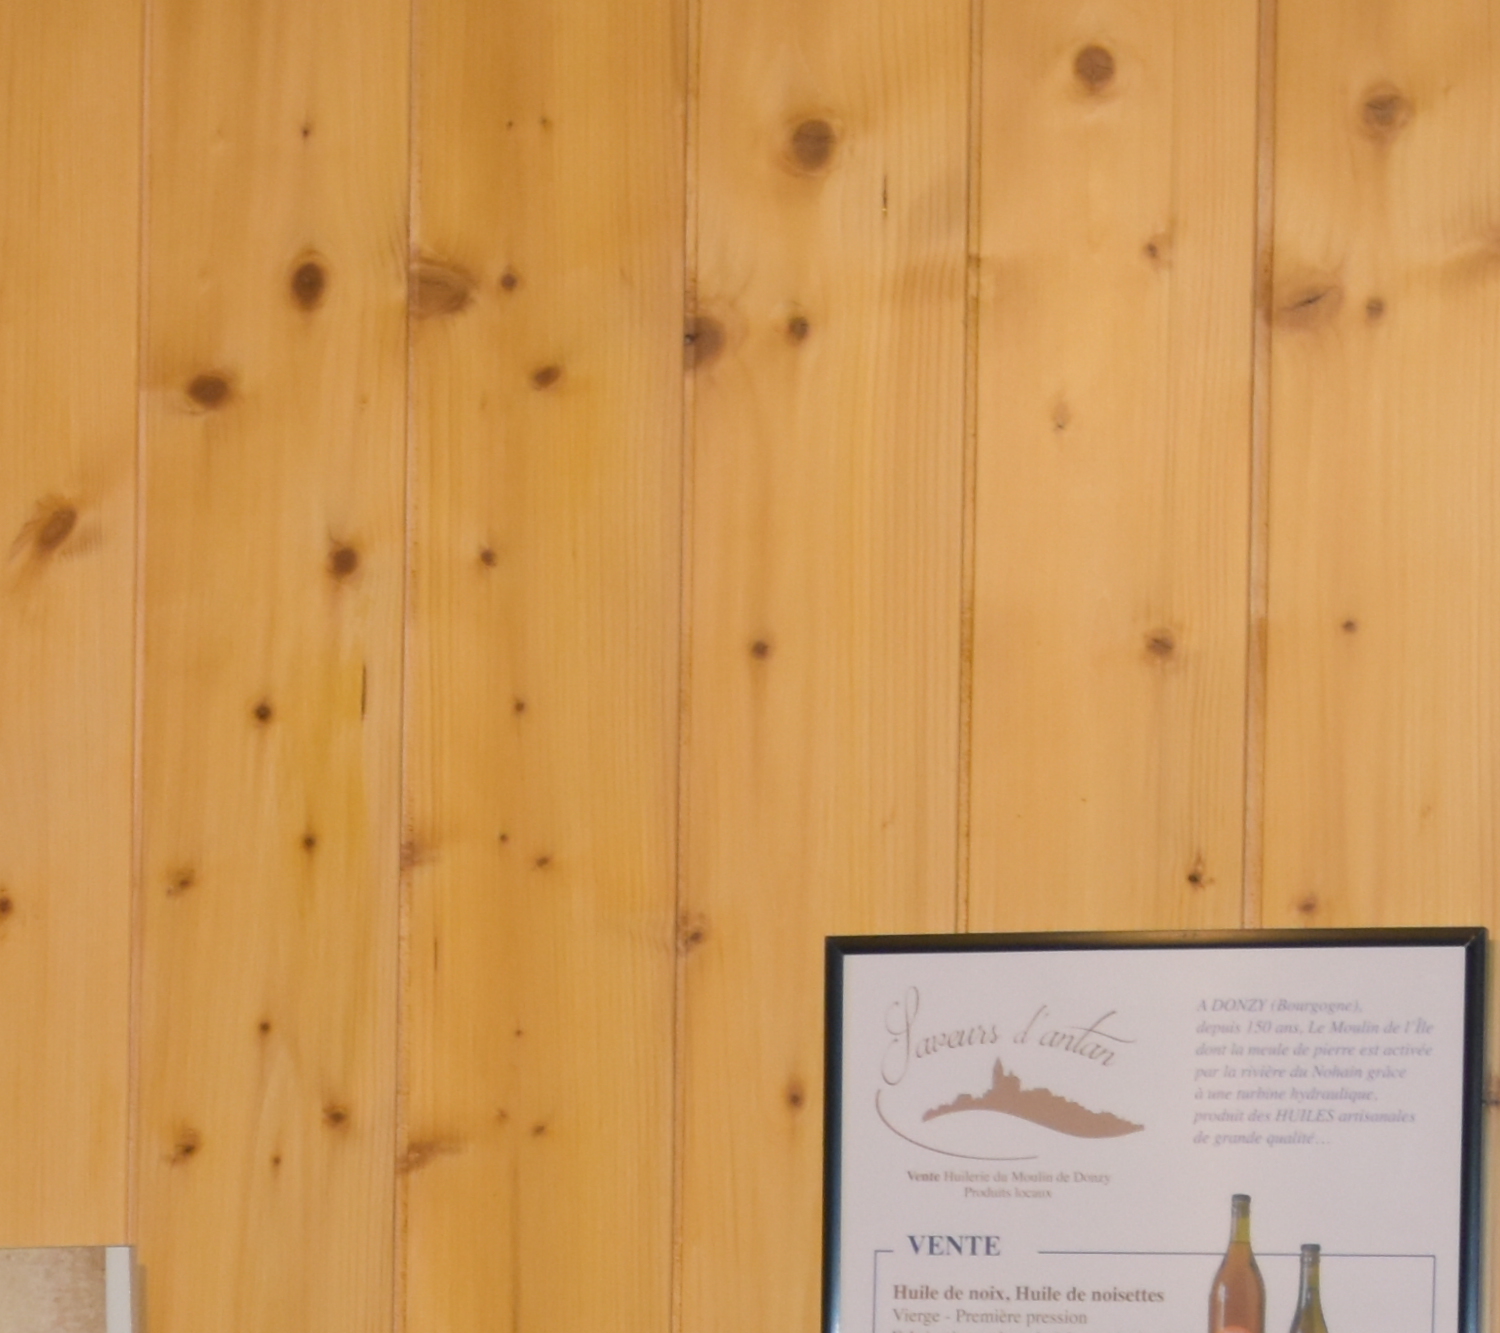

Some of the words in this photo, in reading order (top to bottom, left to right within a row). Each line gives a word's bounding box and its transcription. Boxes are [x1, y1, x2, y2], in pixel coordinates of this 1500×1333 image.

[881, 985, 999, 1086] Saveurs
[907, 1234, 1000, 1256] VENTE
[893, 1284, 938, 1300] Huile
[943, 1285, 963, 1300] de
[1015, 1286, 1061, 1301] Huile
[1066, 1287, 1086, 1302] de
[1091, 1287, 1164, 1302] noisettes
